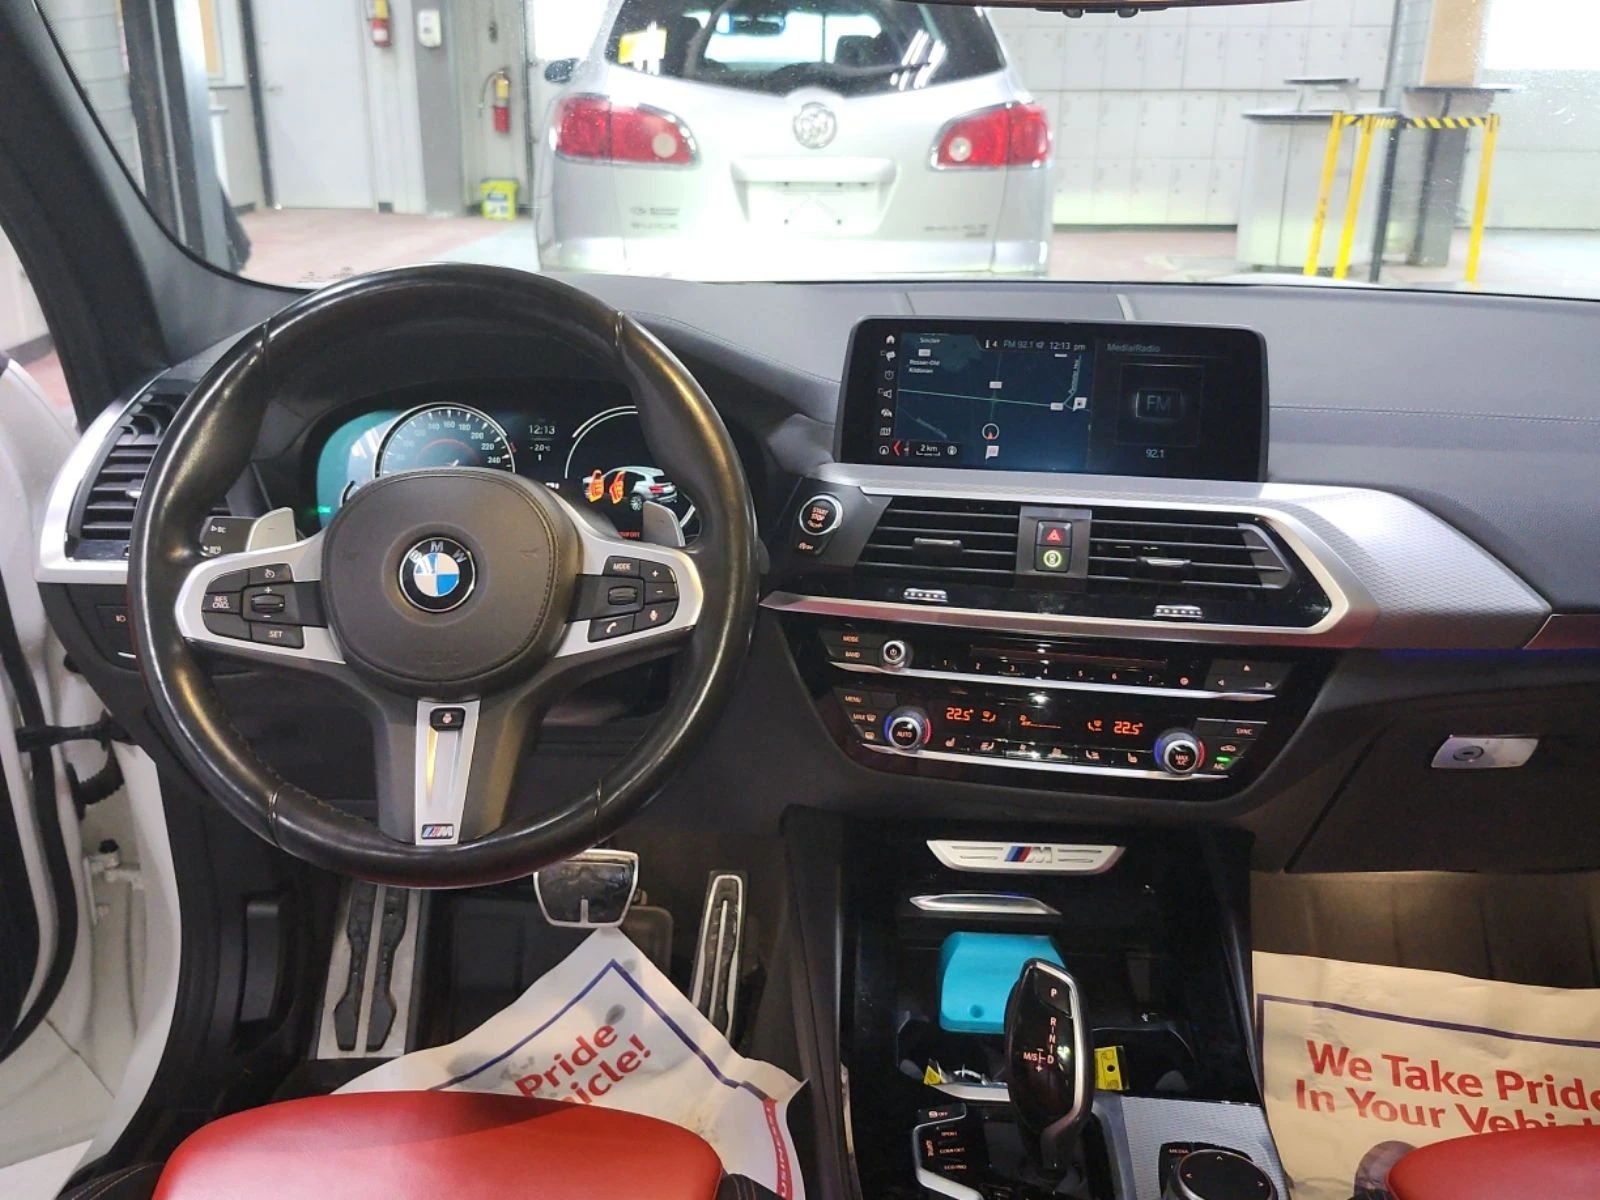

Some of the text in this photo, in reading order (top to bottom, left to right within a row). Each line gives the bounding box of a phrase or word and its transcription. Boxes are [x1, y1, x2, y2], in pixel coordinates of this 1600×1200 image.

[1003, 340, 1016, 348] FM
[1049, 342, 1086, 351] 12:13 pm
[1146, 395, 1172, 411] FM
[528, 424, 556, 435] 12:13
[1145, 449, 1165, 459] 92.1
[487, 456, 501, 464] 240
[408, 540, 468, 563] BMW
[612, 562, 631, 571] MODE
[269, 630, 283, 639] SET
[1050, 988, 1057, 997] P
[1050, 1016, 1057, 1026] R
[1049, 1034, 1056, 1044] N
[514, 1023, 618, 1098] Pride
[1023, 1051, 1054, 1064] M/S D
[561, 1033, 652, 1104] icle!
[1306, 1039, 1373, 1082] We
[1381, 1053, 1483, 1098] Take
[1296, 1079, 1336, 1113] In
[1345, 1087, 1446, 1128] Your
